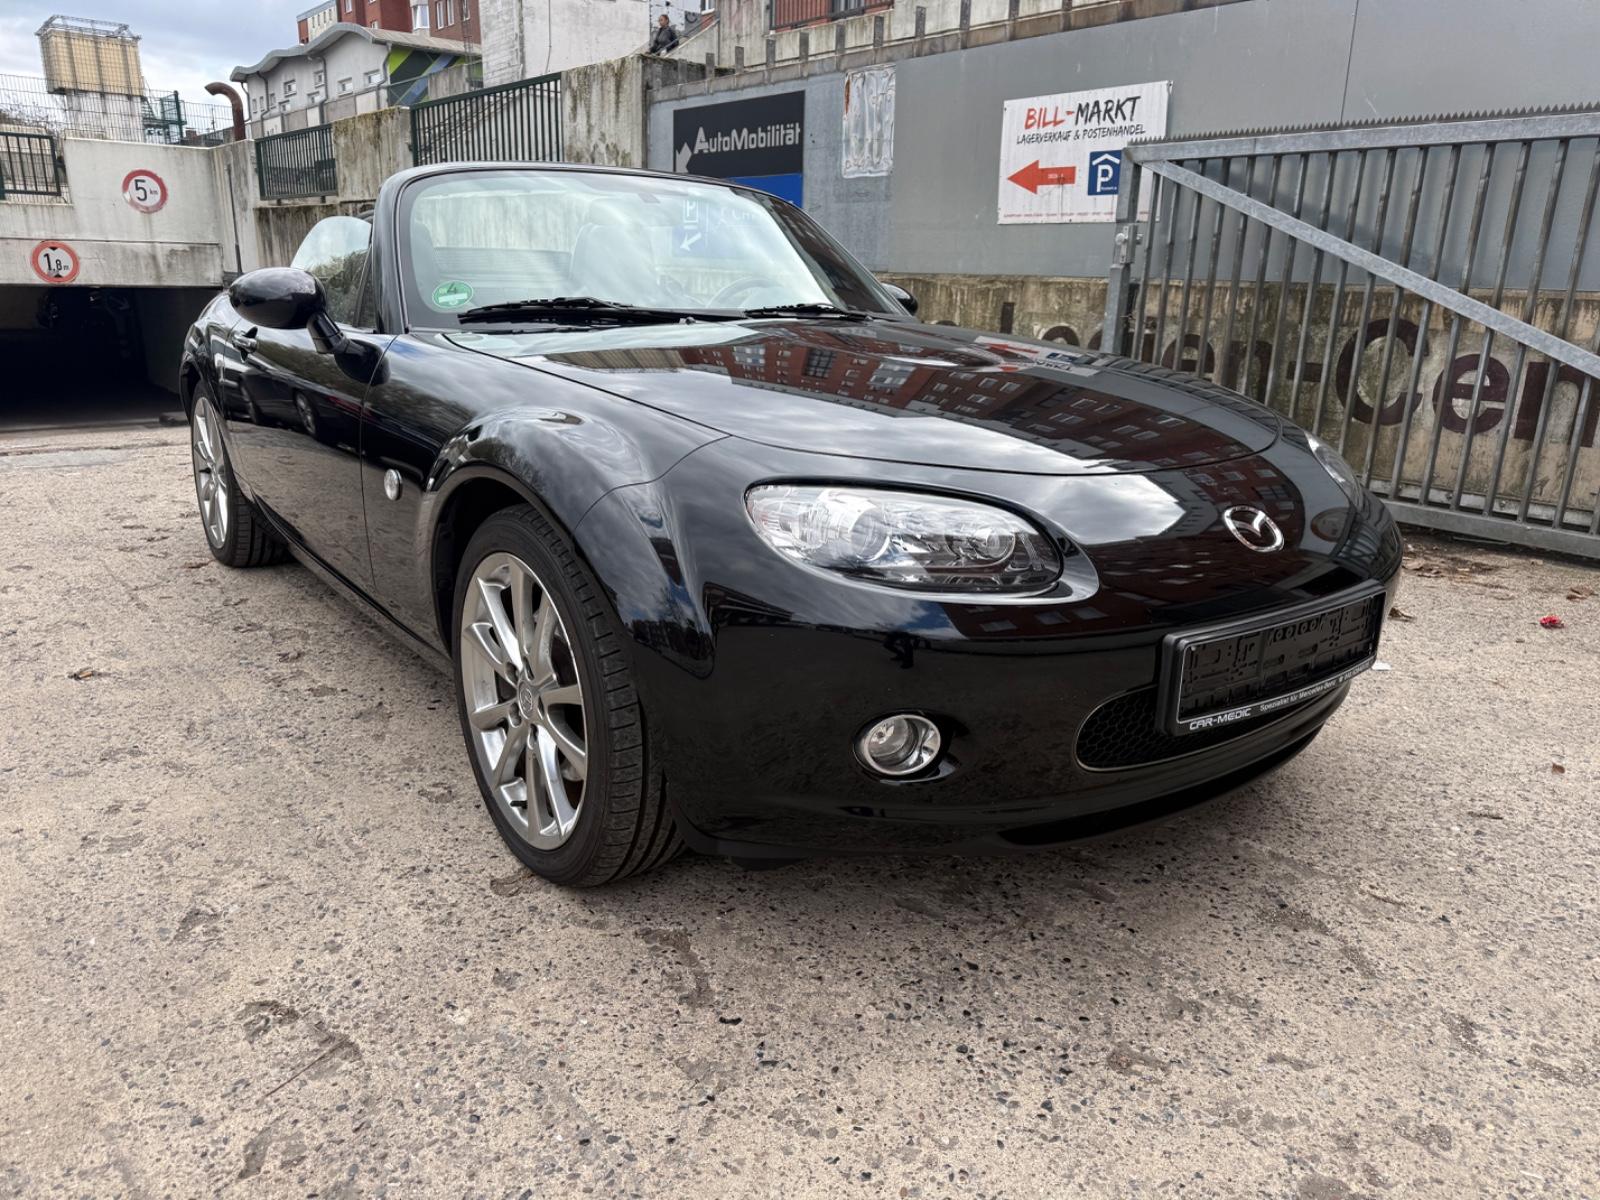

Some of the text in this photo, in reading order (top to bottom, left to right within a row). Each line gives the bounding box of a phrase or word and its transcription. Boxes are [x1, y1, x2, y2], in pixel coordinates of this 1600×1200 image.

[1024, 96, 1142, 130] BILL-MARKT
[693, 122, 801, 155] AutoMobilität
[1016, 123, 1147, 145] LAGERVERKAUF & POSTENHANDEL
[134, 178, 148, 202] 5
[1096, 164, 1114, 193] P
[1189, 708, 1252, 731] CAR-MEDIC
